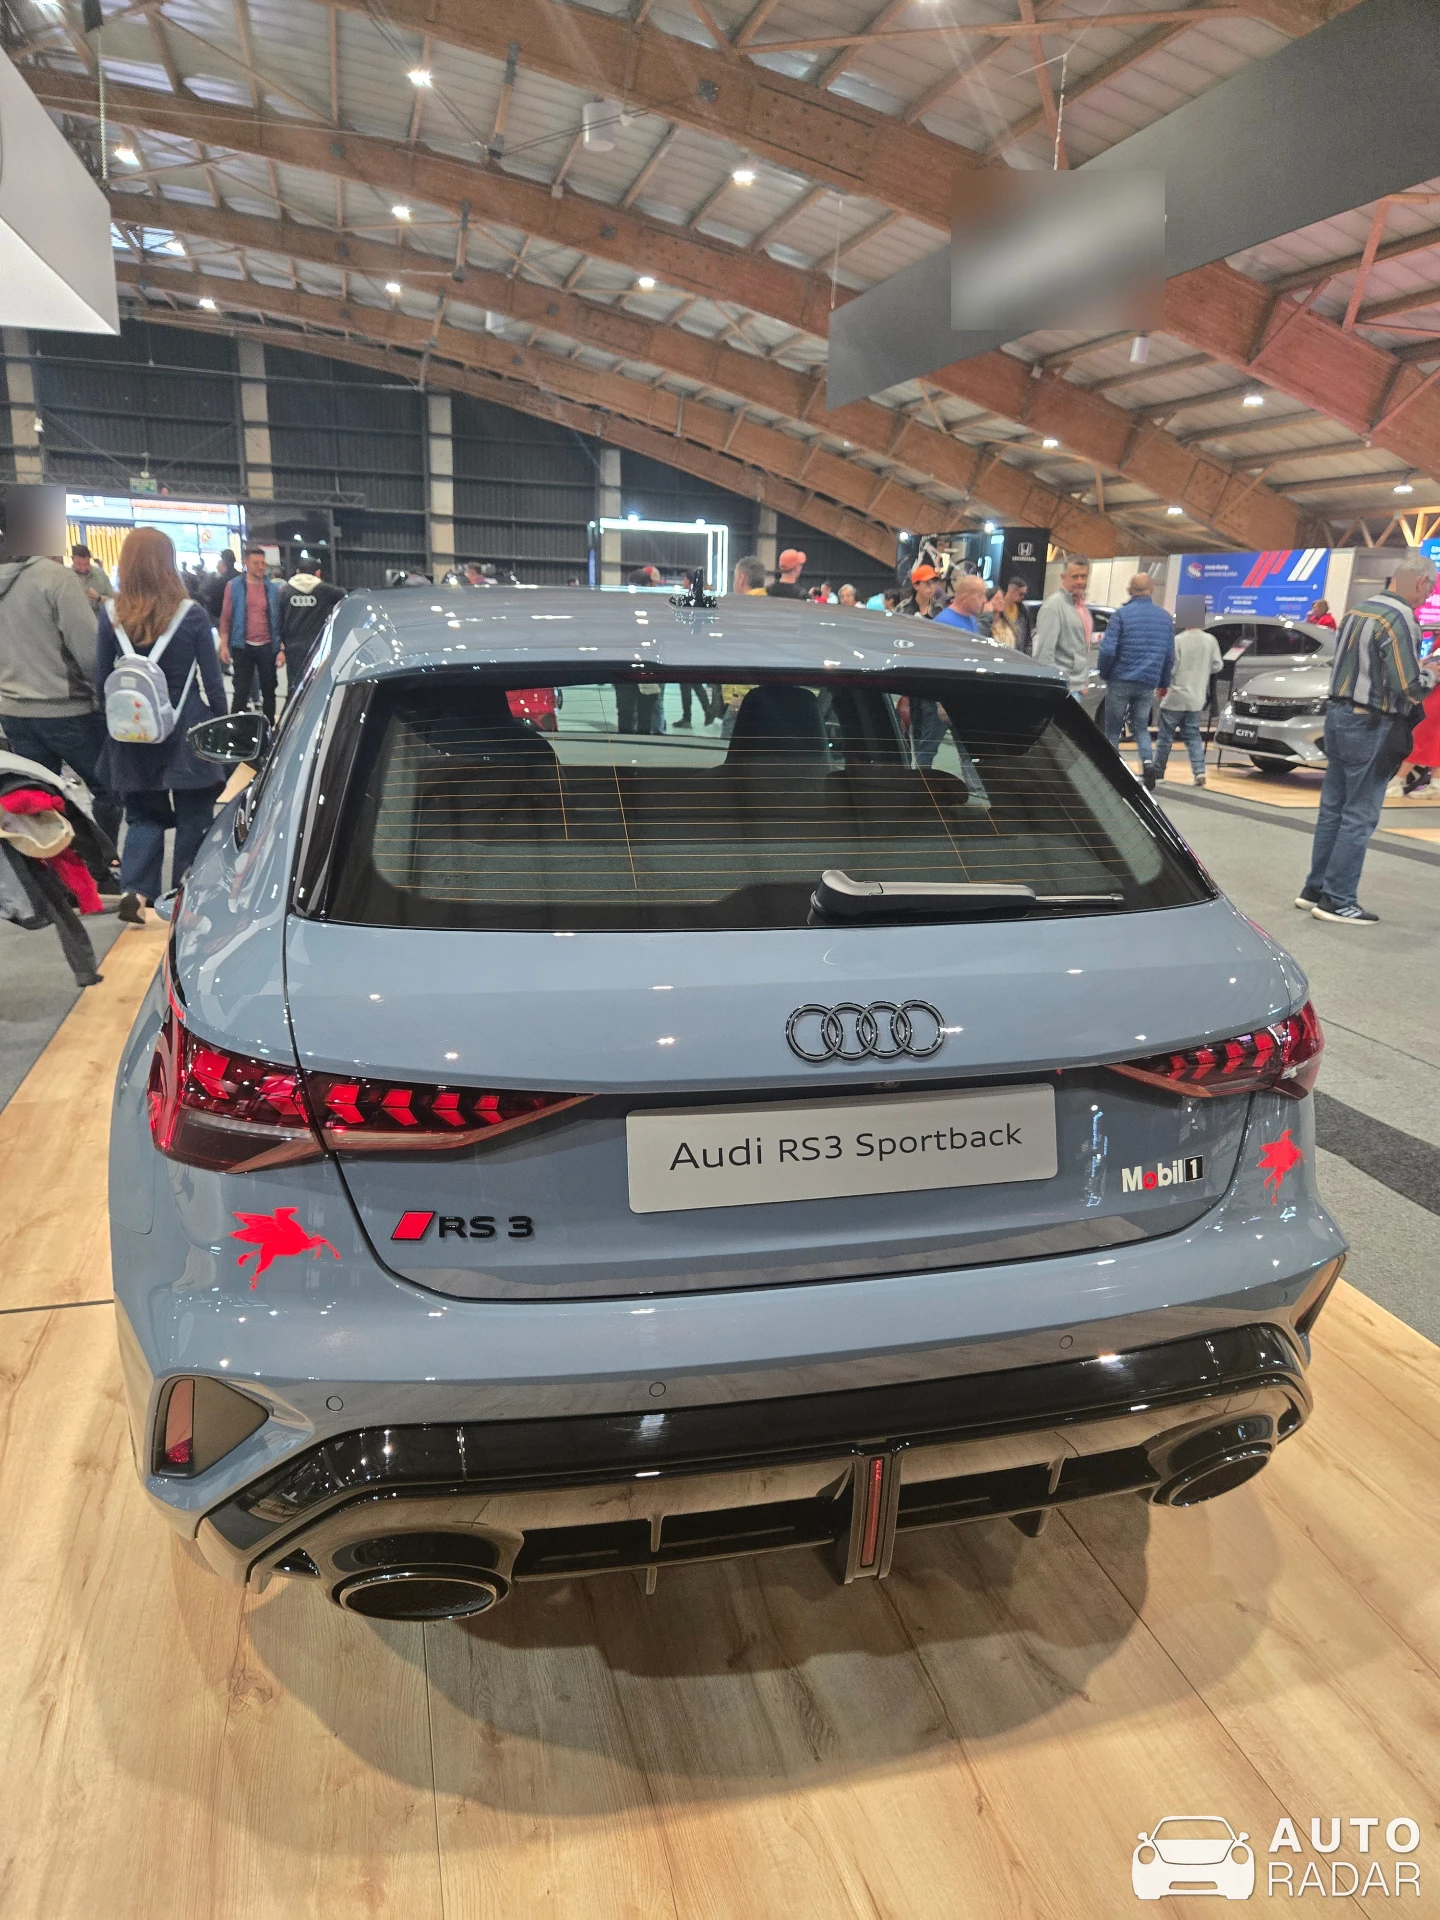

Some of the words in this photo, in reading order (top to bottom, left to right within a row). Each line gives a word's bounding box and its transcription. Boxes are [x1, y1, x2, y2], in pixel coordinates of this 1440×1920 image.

[1235, 728, 1256, 738] CITY
[669, 1137, 763, 1171] Audi
[778, 1135, 844, 1163] RS3
[855, 1123, 1023, 1161] Sportback
[438, 1215, 497, 1239] RS
[507, 1215, 534, 1238] 3
